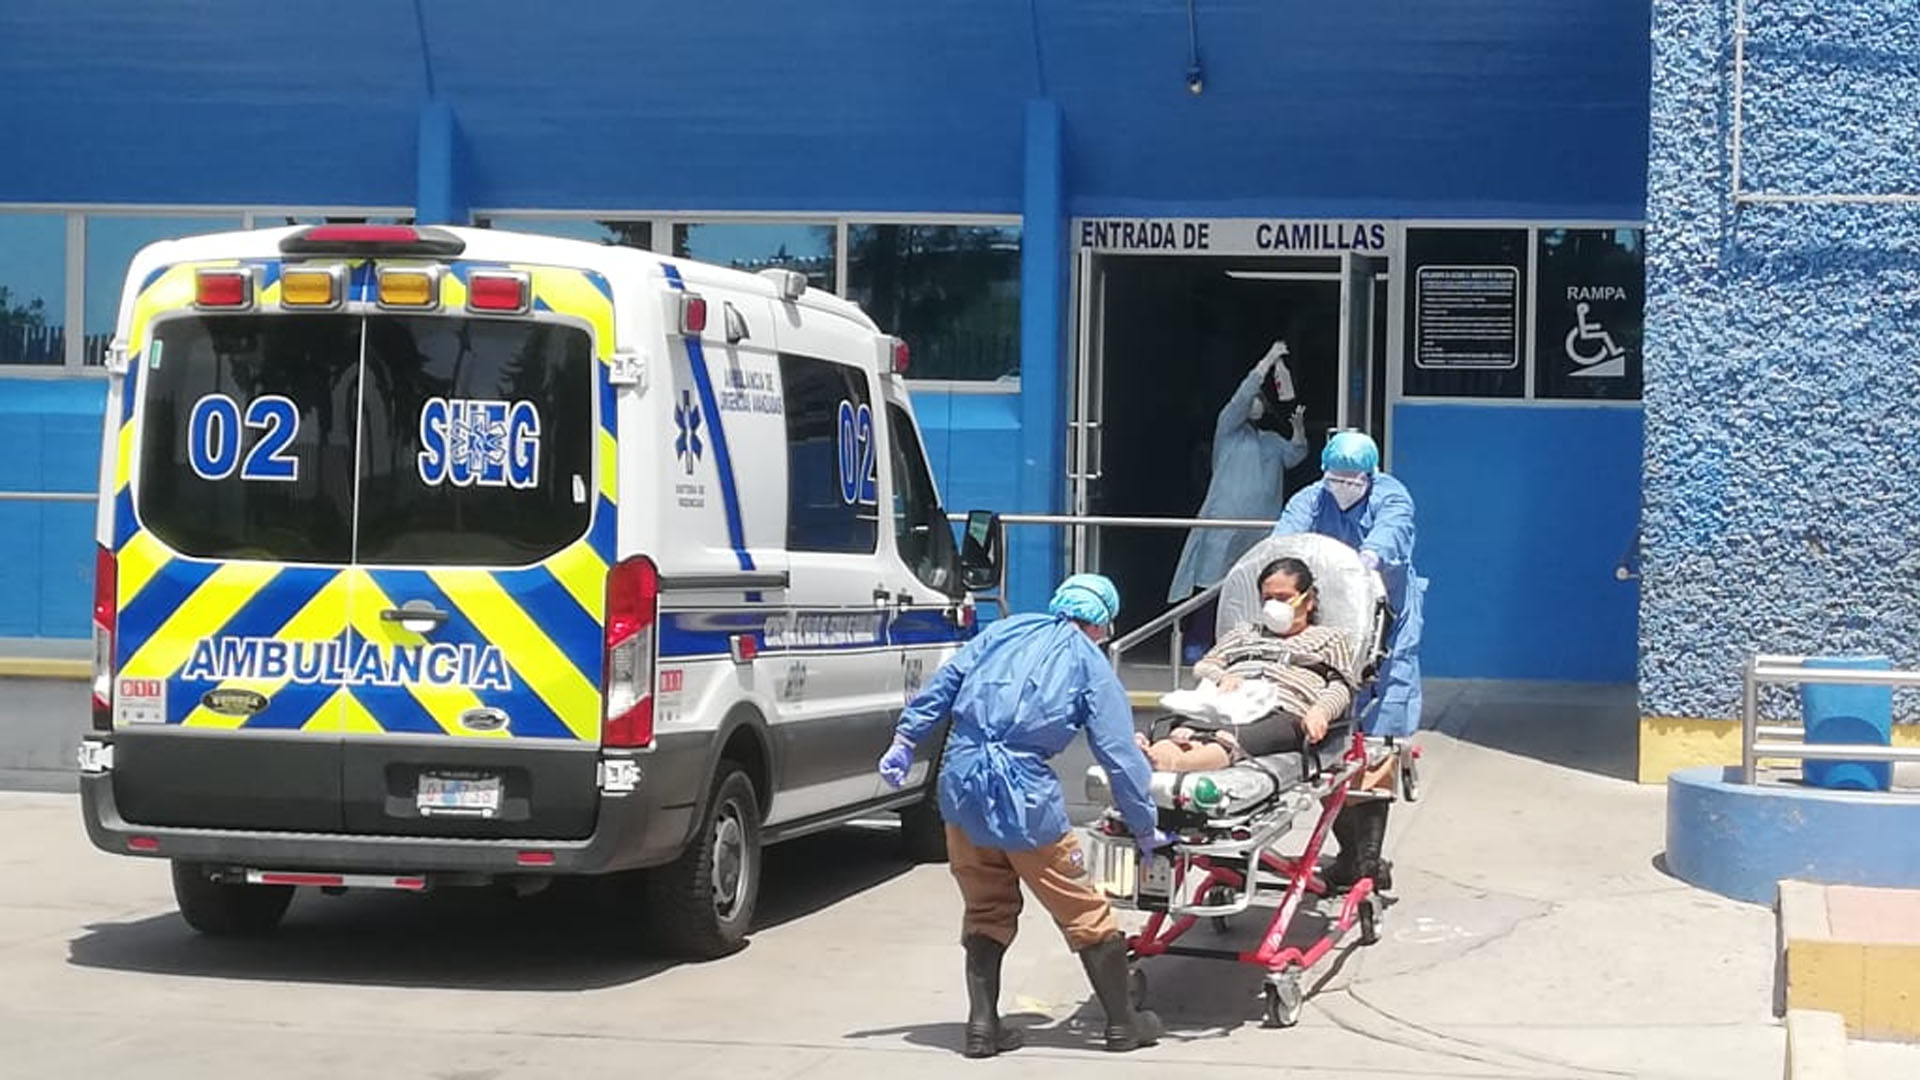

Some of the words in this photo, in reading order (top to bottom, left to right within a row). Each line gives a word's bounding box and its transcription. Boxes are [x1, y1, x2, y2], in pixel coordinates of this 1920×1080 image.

[1081, 220, 1177, 249] ENTRADA
[1183, 222, 1210, 250] DE
[1256, 222, 1386, 251] CAMILLAS
[1566, 286, 1627, 301] RAMPA
[188, 393, 300, 481] 02
[838, 399, 878, 506] 02
[181, 635, 513, 691] AMBULANCIA
